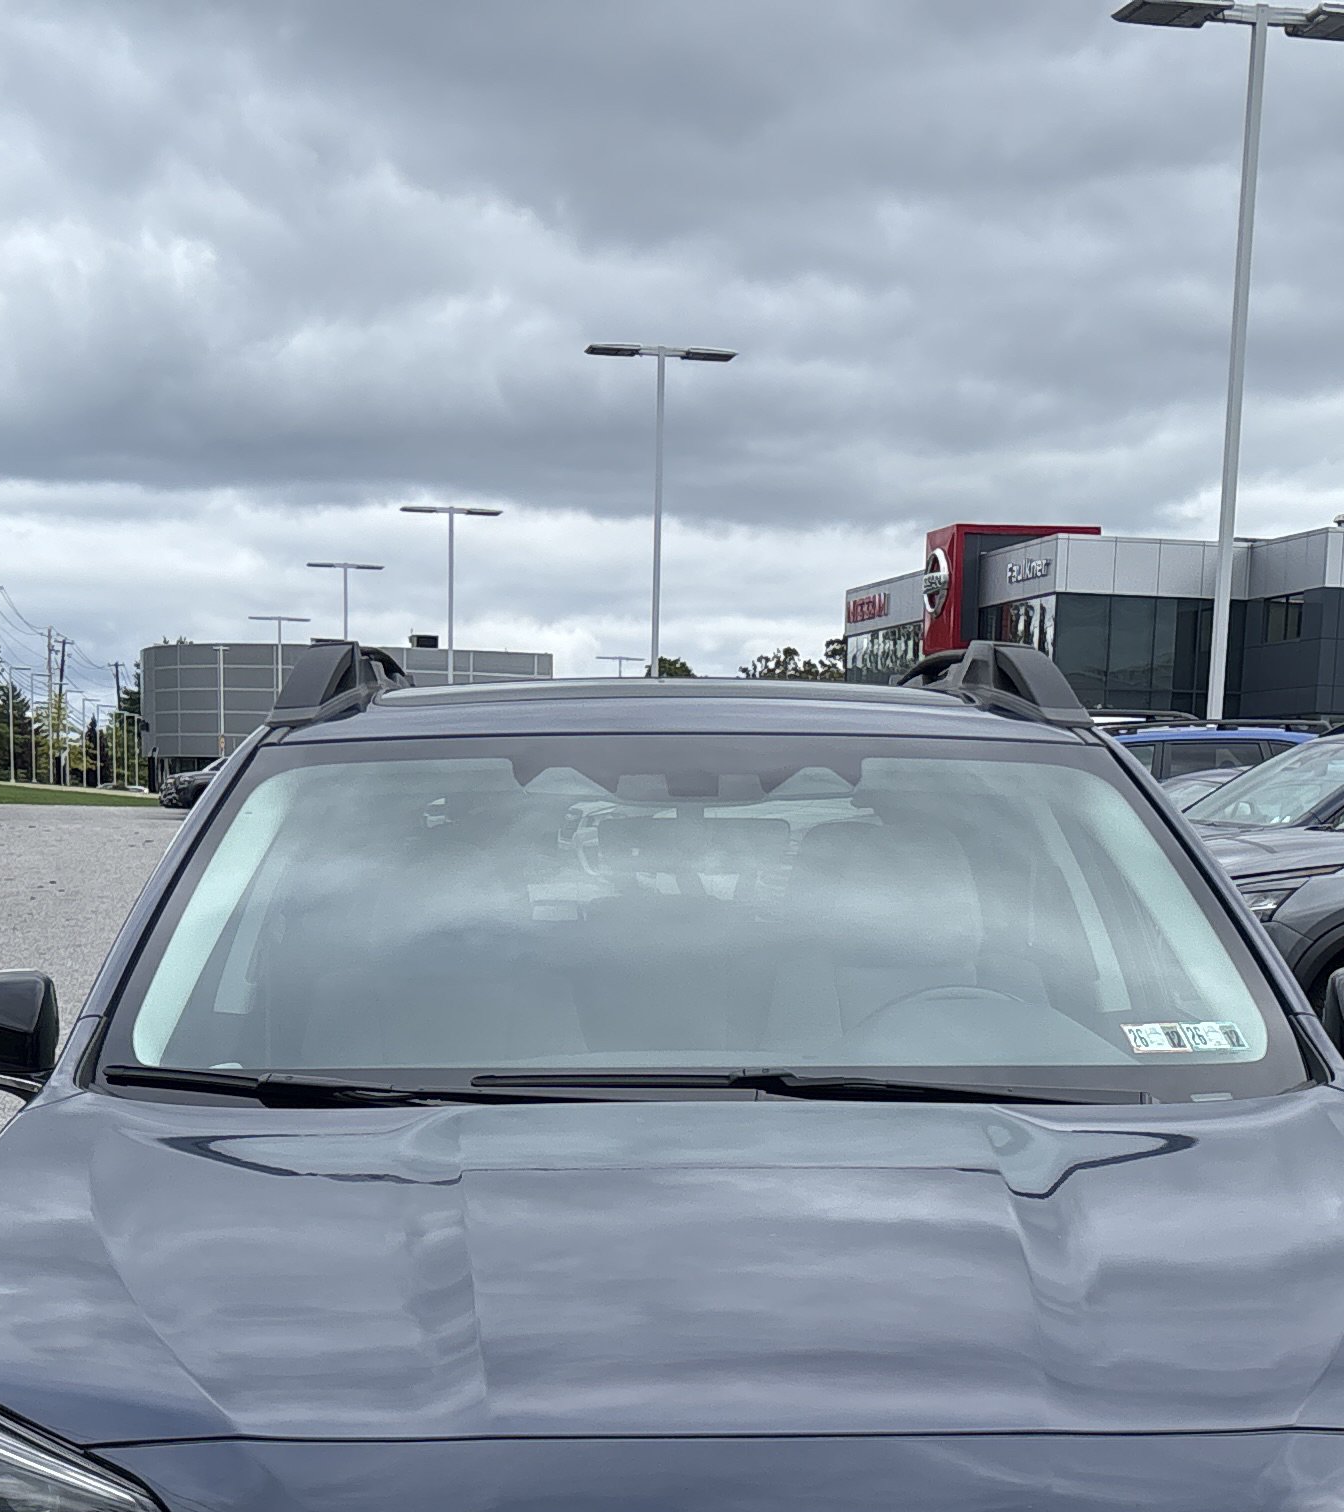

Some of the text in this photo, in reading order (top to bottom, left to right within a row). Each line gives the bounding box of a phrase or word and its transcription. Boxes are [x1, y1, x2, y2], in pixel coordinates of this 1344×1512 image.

[1007, 558, 1051, 584] Faulkner
[1128, 1028, 1188, 1049] 26 12
[1186, 1026, 1247, 1048] 26 12
